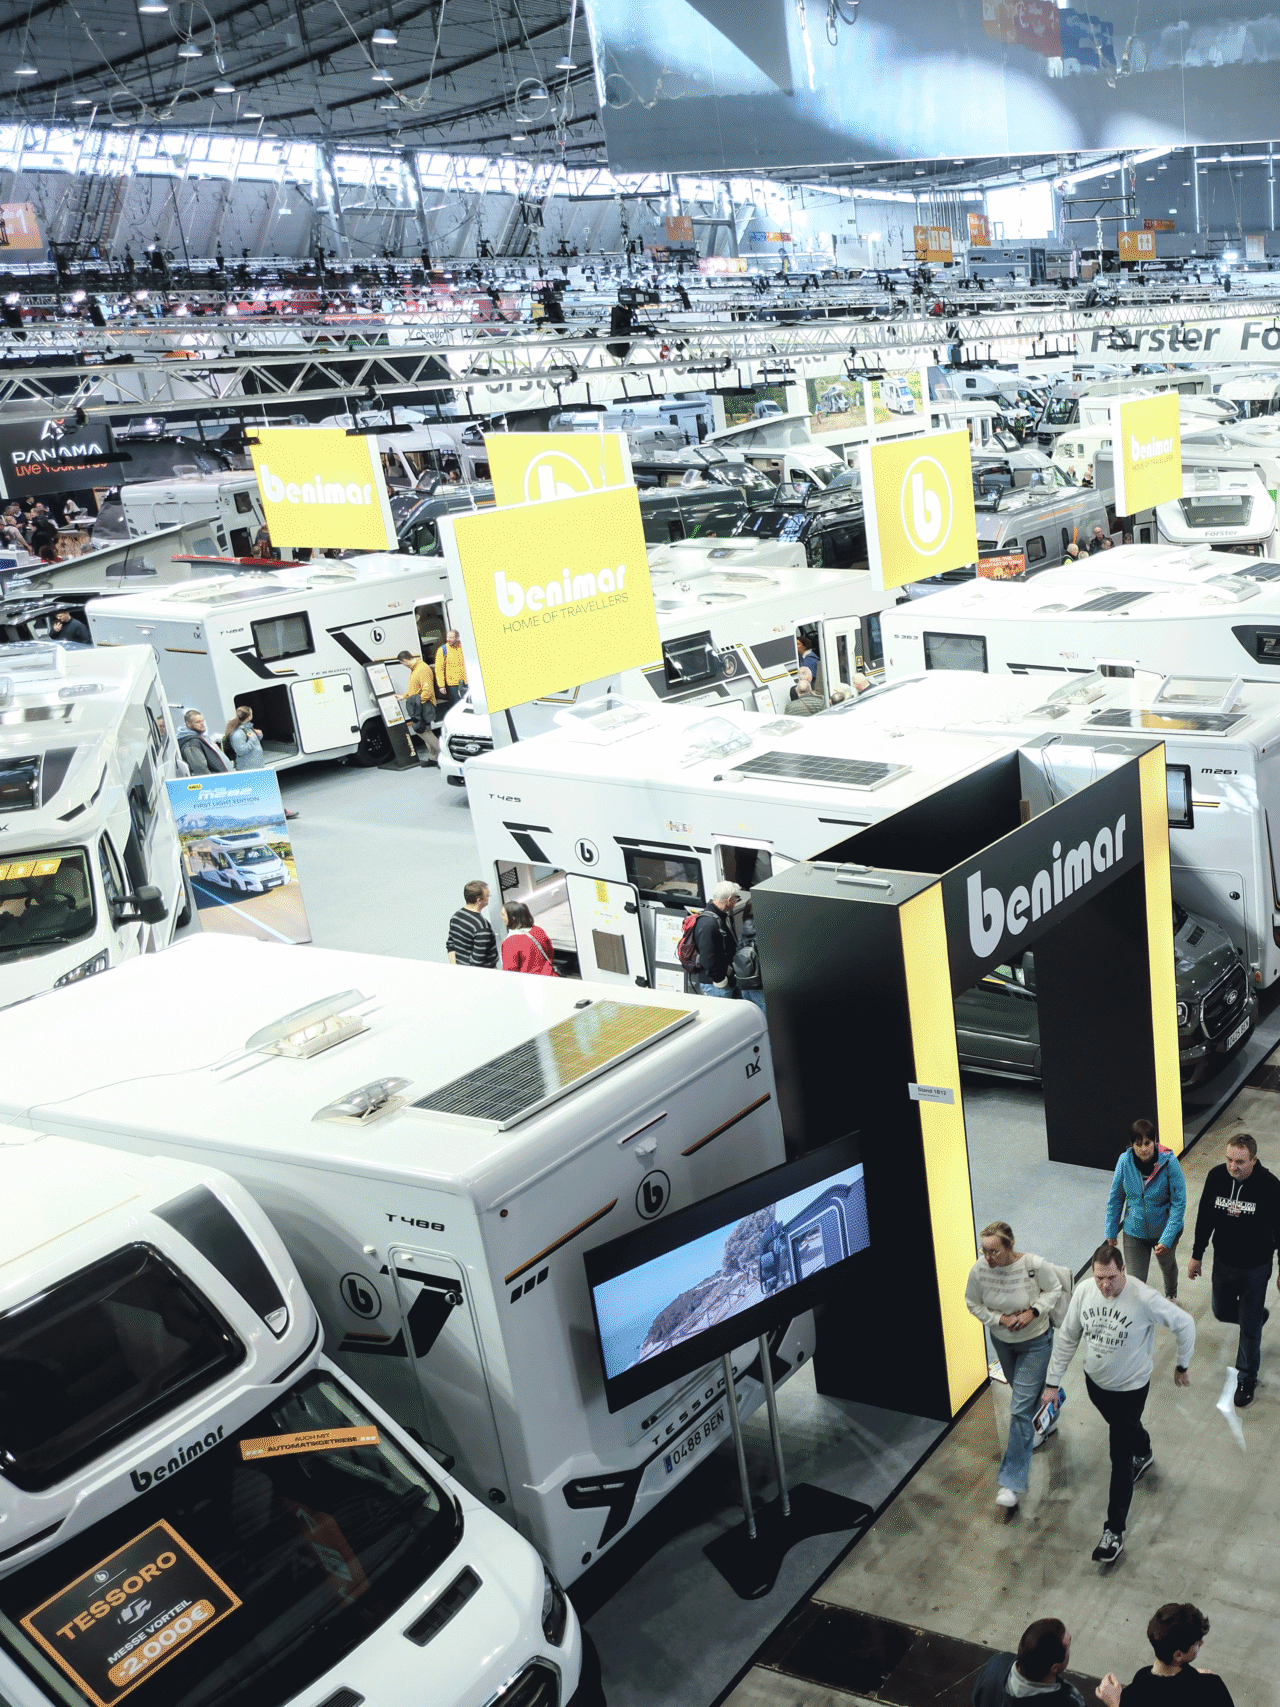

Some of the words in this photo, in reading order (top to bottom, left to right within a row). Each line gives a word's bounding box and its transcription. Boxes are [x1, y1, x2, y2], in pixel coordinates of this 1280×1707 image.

[12, 443, 104, 464] PANAMA
[1130, 433, 1174, 463] benimar
[260, 464, 373, 506] benimar
[1204, 529, 1239, 538] Forster
[493, 564, 626, 618] benimar
[503, 615, 541, 634] HOME
[543, 611, 559, 625] OF
[560, 592, 630, 619] TRAVELLERS
[311, 666, 353, 677] TESSORO
[966, 813, 1127, 959] benimar
[917, 1086, 932, 1094] Stand
[385, 1212, 398, 1222] T
[400, 1216, 446, 1232] 488
[267, 1435, 359, 1453] AUTOMATIKGETRIEBE
[294, 1433, 315, 1442] AUCH
[672, 1431, 702, 1465] 0488
[703, 1408, 725, 1438] BEN
[129, 1424, 225, 1493] benimar
[56, 1551, 178, 1641] TESSORO
[107, 1632, 147, 1665] MESSE
[145, 1599, 193, 1634] VORTEIL
[118, 1604, 209, 1678] -2.000€
